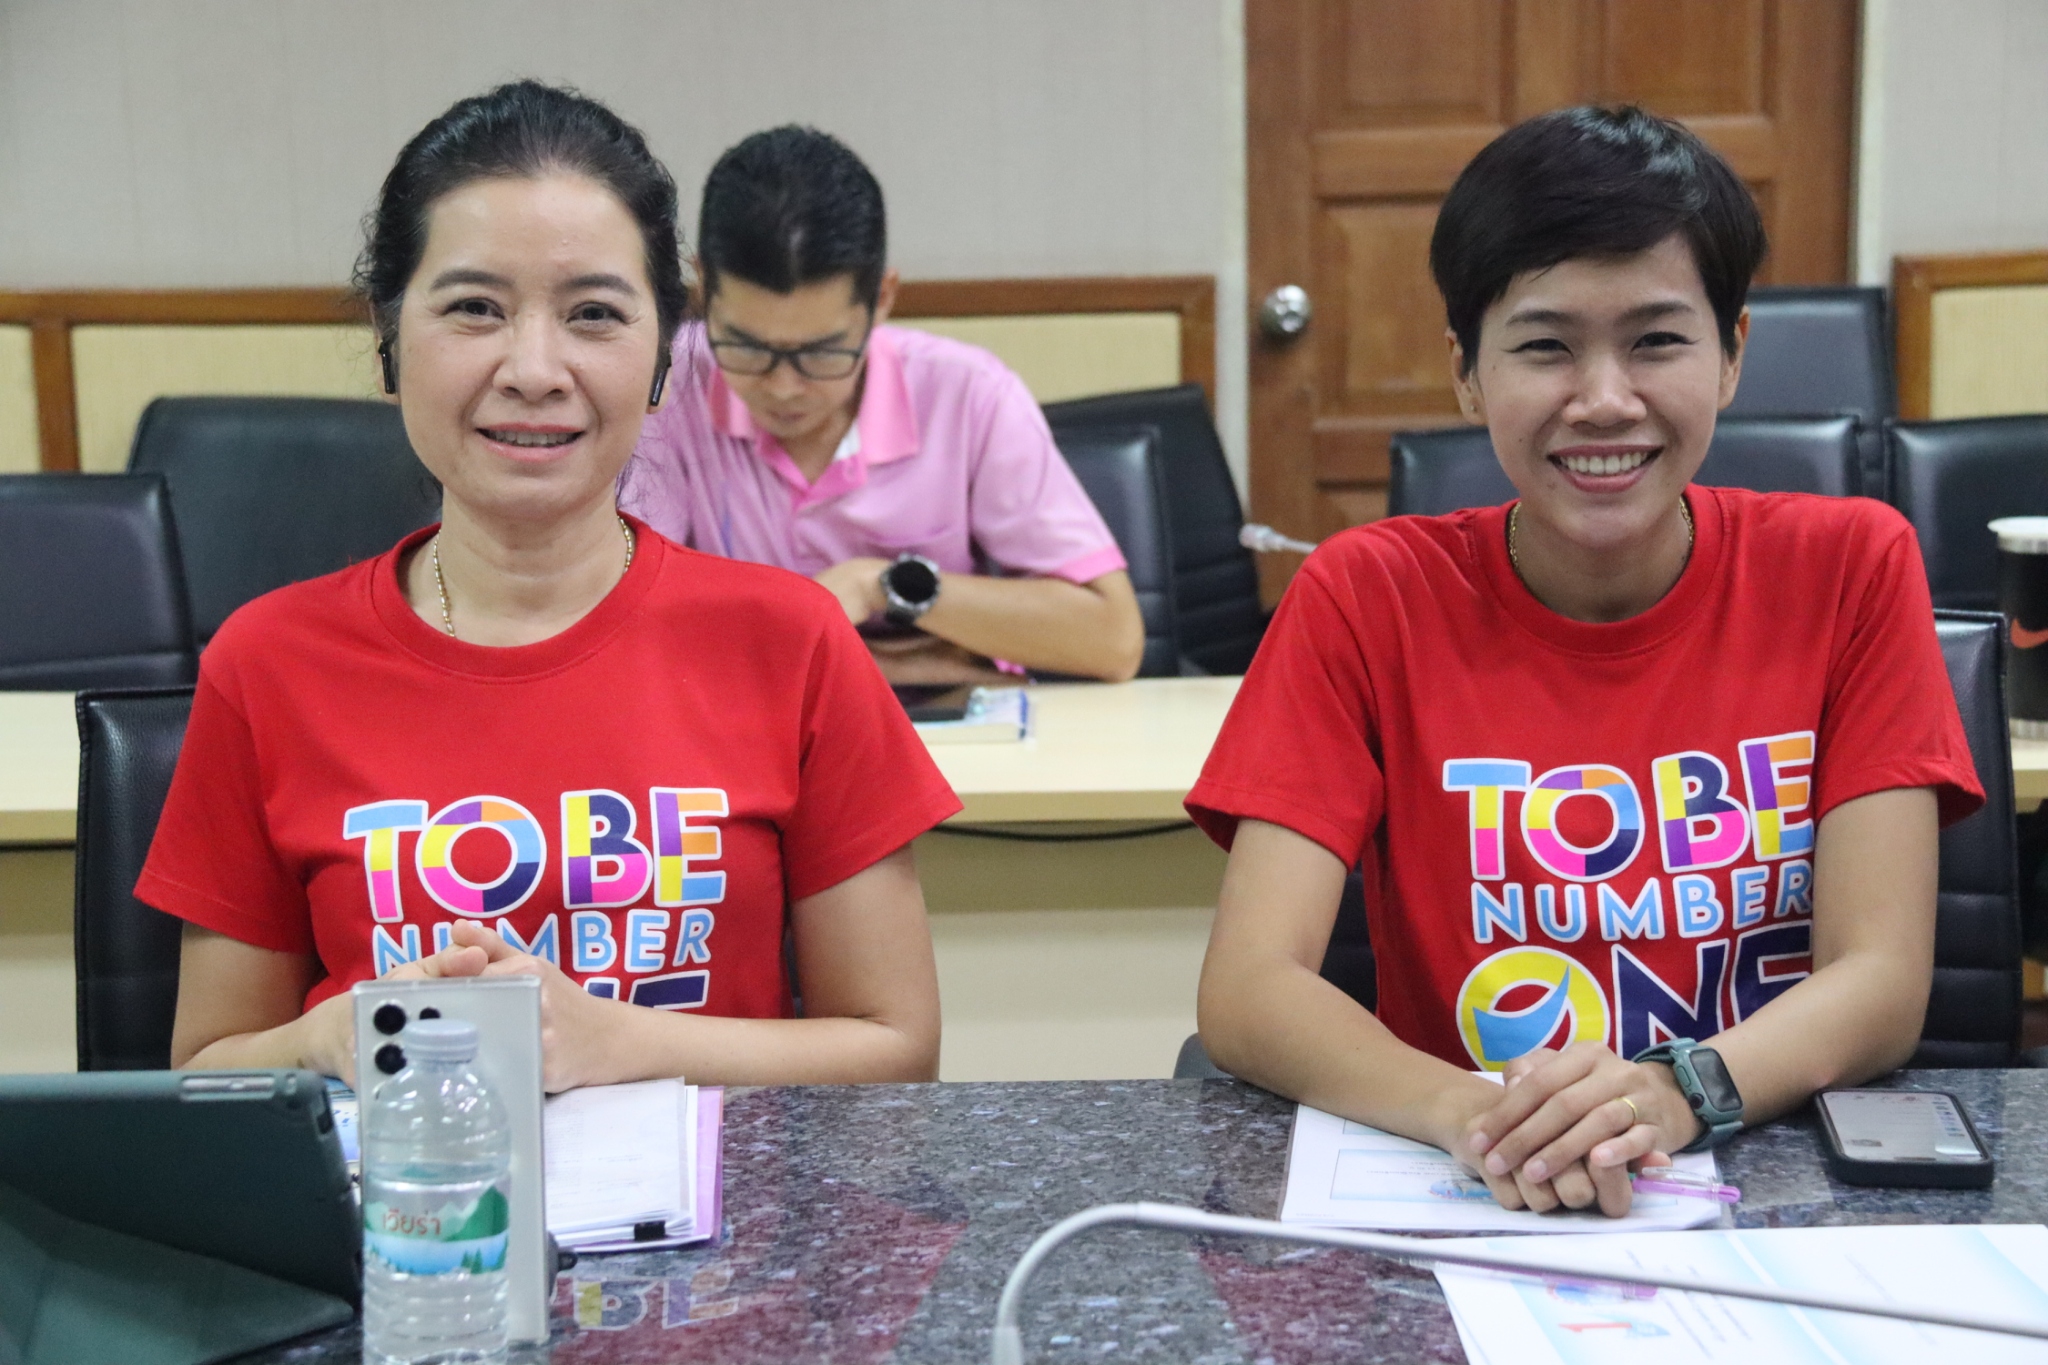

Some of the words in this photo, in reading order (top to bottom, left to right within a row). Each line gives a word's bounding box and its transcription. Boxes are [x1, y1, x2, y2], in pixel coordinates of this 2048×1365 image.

[343, 795, 546, 923] TO
[560, 787, 729, 907] BE
[1443, 758, 1645, 883] TO
[1652, 731, 1815, 873] BE
[1471, 860, 1813, 943] NUMBER
